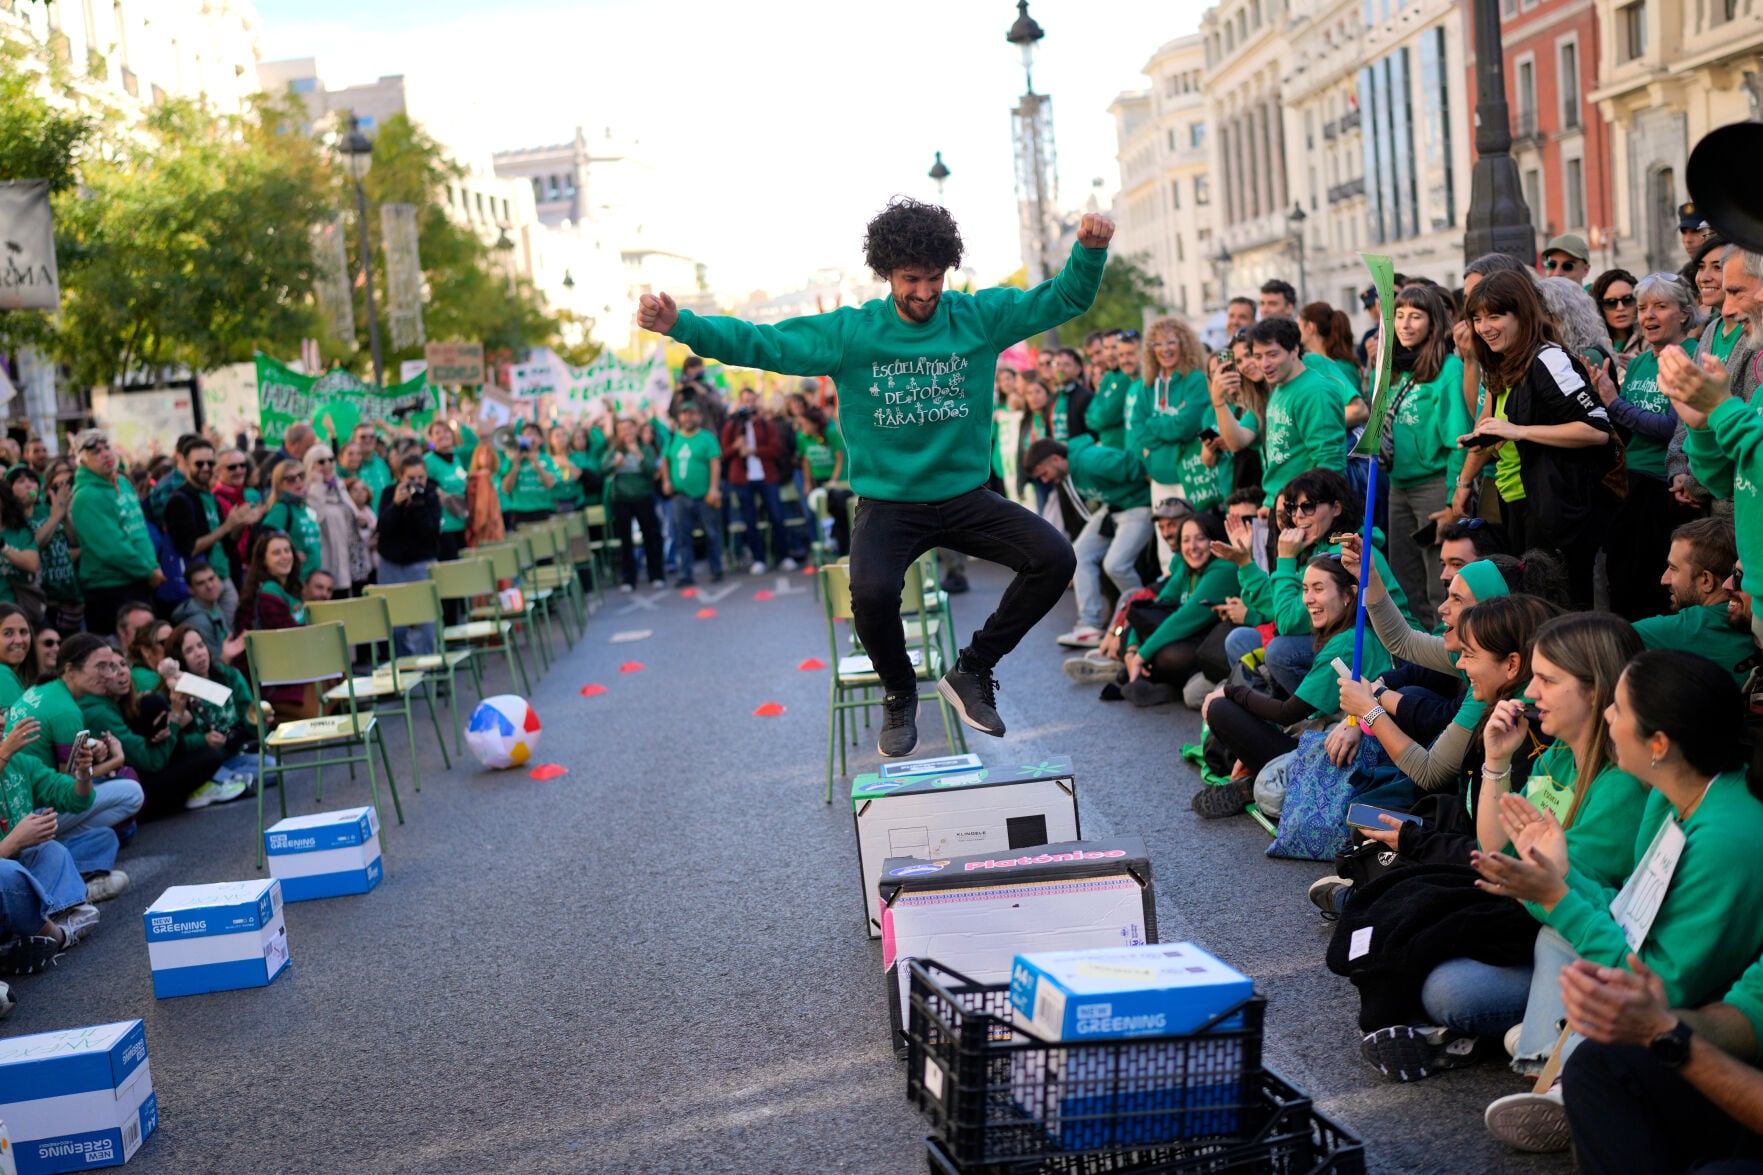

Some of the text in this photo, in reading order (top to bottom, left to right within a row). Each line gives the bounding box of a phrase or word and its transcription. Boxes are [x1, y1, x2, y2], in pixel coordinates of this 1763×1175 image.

[270, 837, 316, 850] GREENING
[964, 850, 1127, 871] Platónico
[152, 917, 172, 925] NEW
[152, 920, 207, 934] GREENING
[1076, 1013, 1167, 1035] GREENING
[38, 1139, 113, 1159] GREENING
[87, 1150, 112, 1162] NEW
